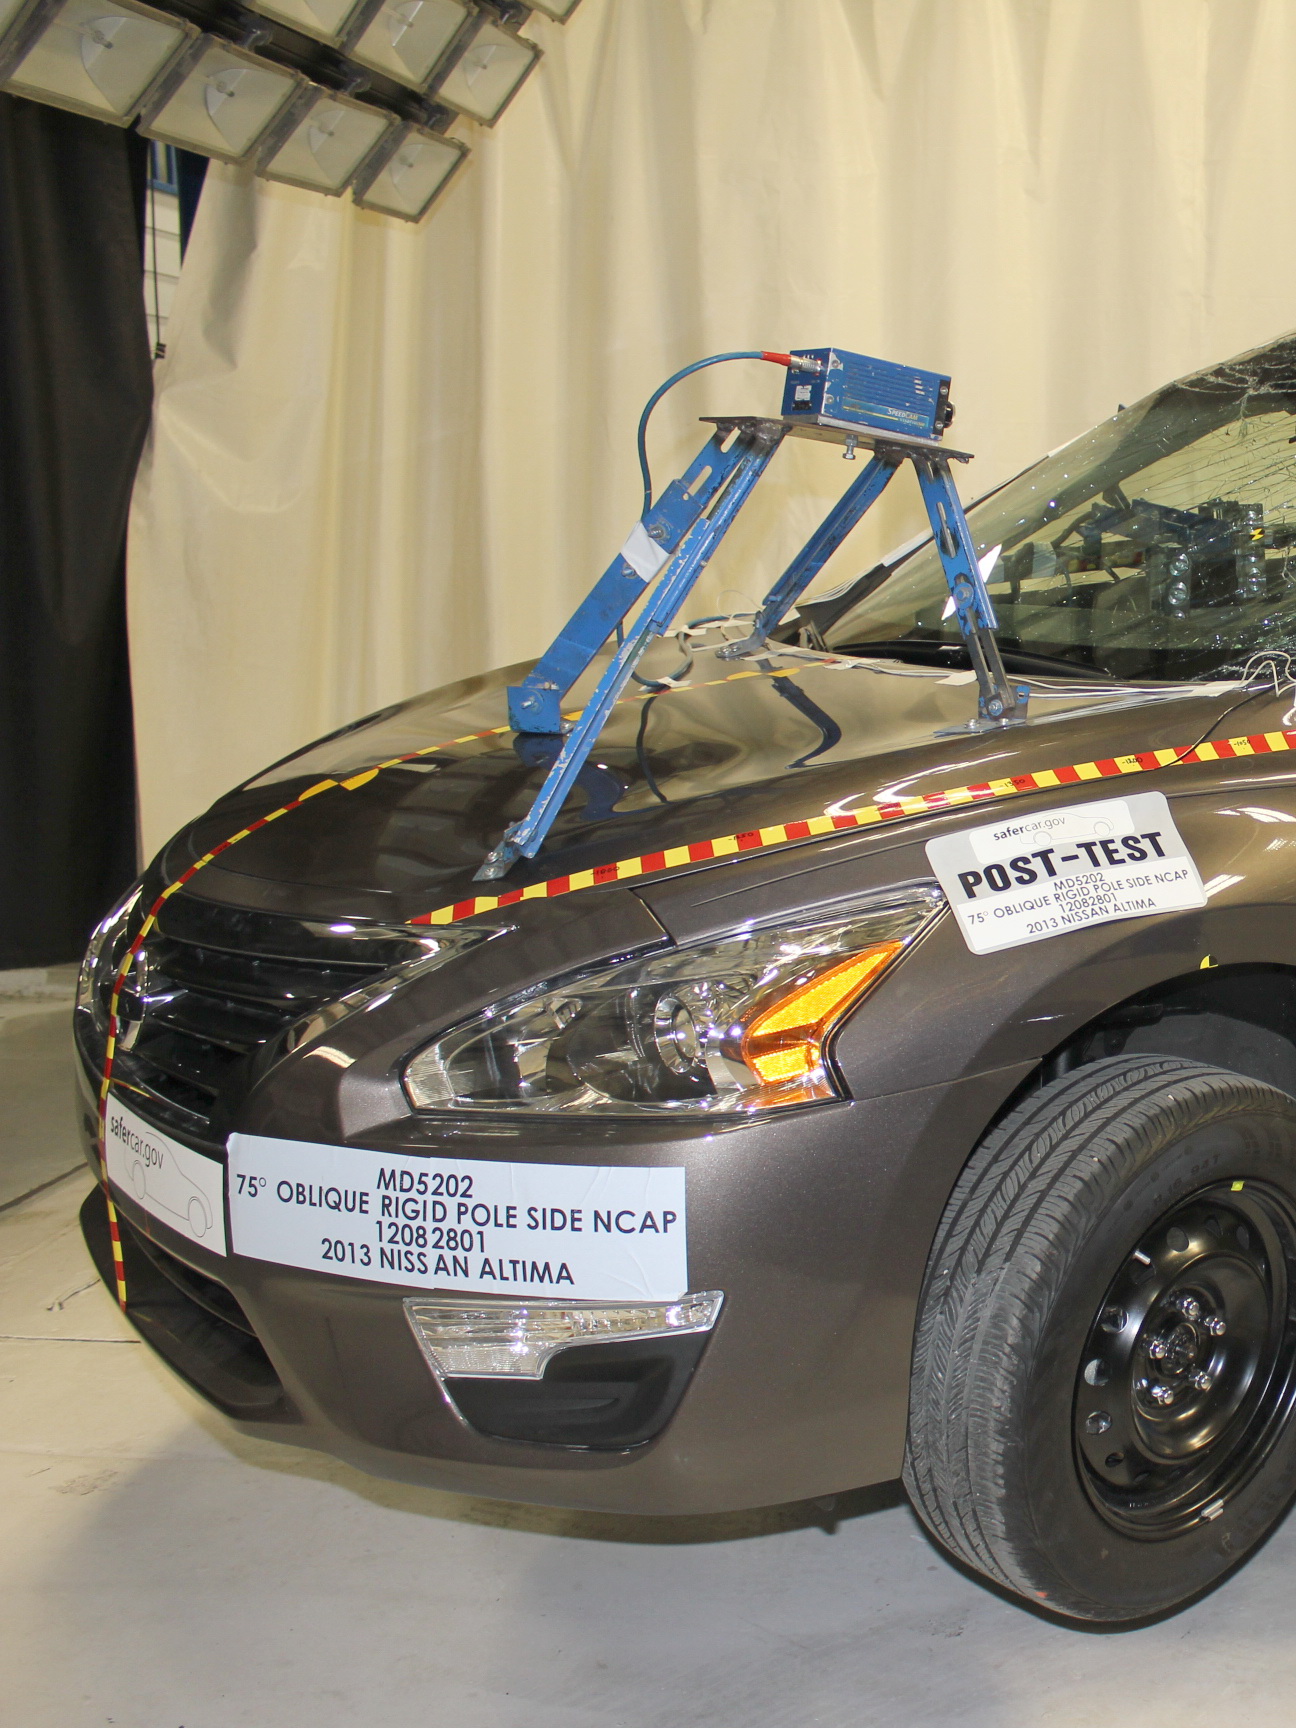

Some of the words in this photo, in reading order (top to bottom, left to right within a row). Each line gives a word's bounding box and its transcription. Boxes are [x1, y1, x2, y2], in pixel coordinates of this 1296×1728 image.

[993, 817, 1066, 840] safercar.gov
[957, 832, 1165, 899] POST-TEST
[1054, 872, 1105, 891] MD5202
[993, 896, 1051, 918] OBLIQUE
[1054, 886, 1090, 903] RIGID
[1093, 880, 1124, 893] POLE
[1126, 876, 1152, 888] SIDE
[1154, 870, 1188, 883] NCAP
[1059, 893, 1117, 913] 12082801
[1026, 918, 1058, 934] 2013
[1060, 905, 1109, 925] NISSAN
[1113, 898, 1156, 914] ALTIMA
[110, 1116, 163, 1169] safercar.gov
[376, 1167, 473, 1198] MD5202
[277, 1180, 369, 1214] OBLIQUE
[381, 1195, 447, 1223] RIGID
[457, 1202, 517, 1228] POLE
[527, 1206, 582, 1232] SIDE
[593, 1210, 677, 1233] NCAP
[376, 1220, 485, 1253] 12082801
[321, 1237, 371, 1266] 2013
[380, 1247, 469, 1278] NISSAN
[479, 1257, 575, 1285] ALTIMA
